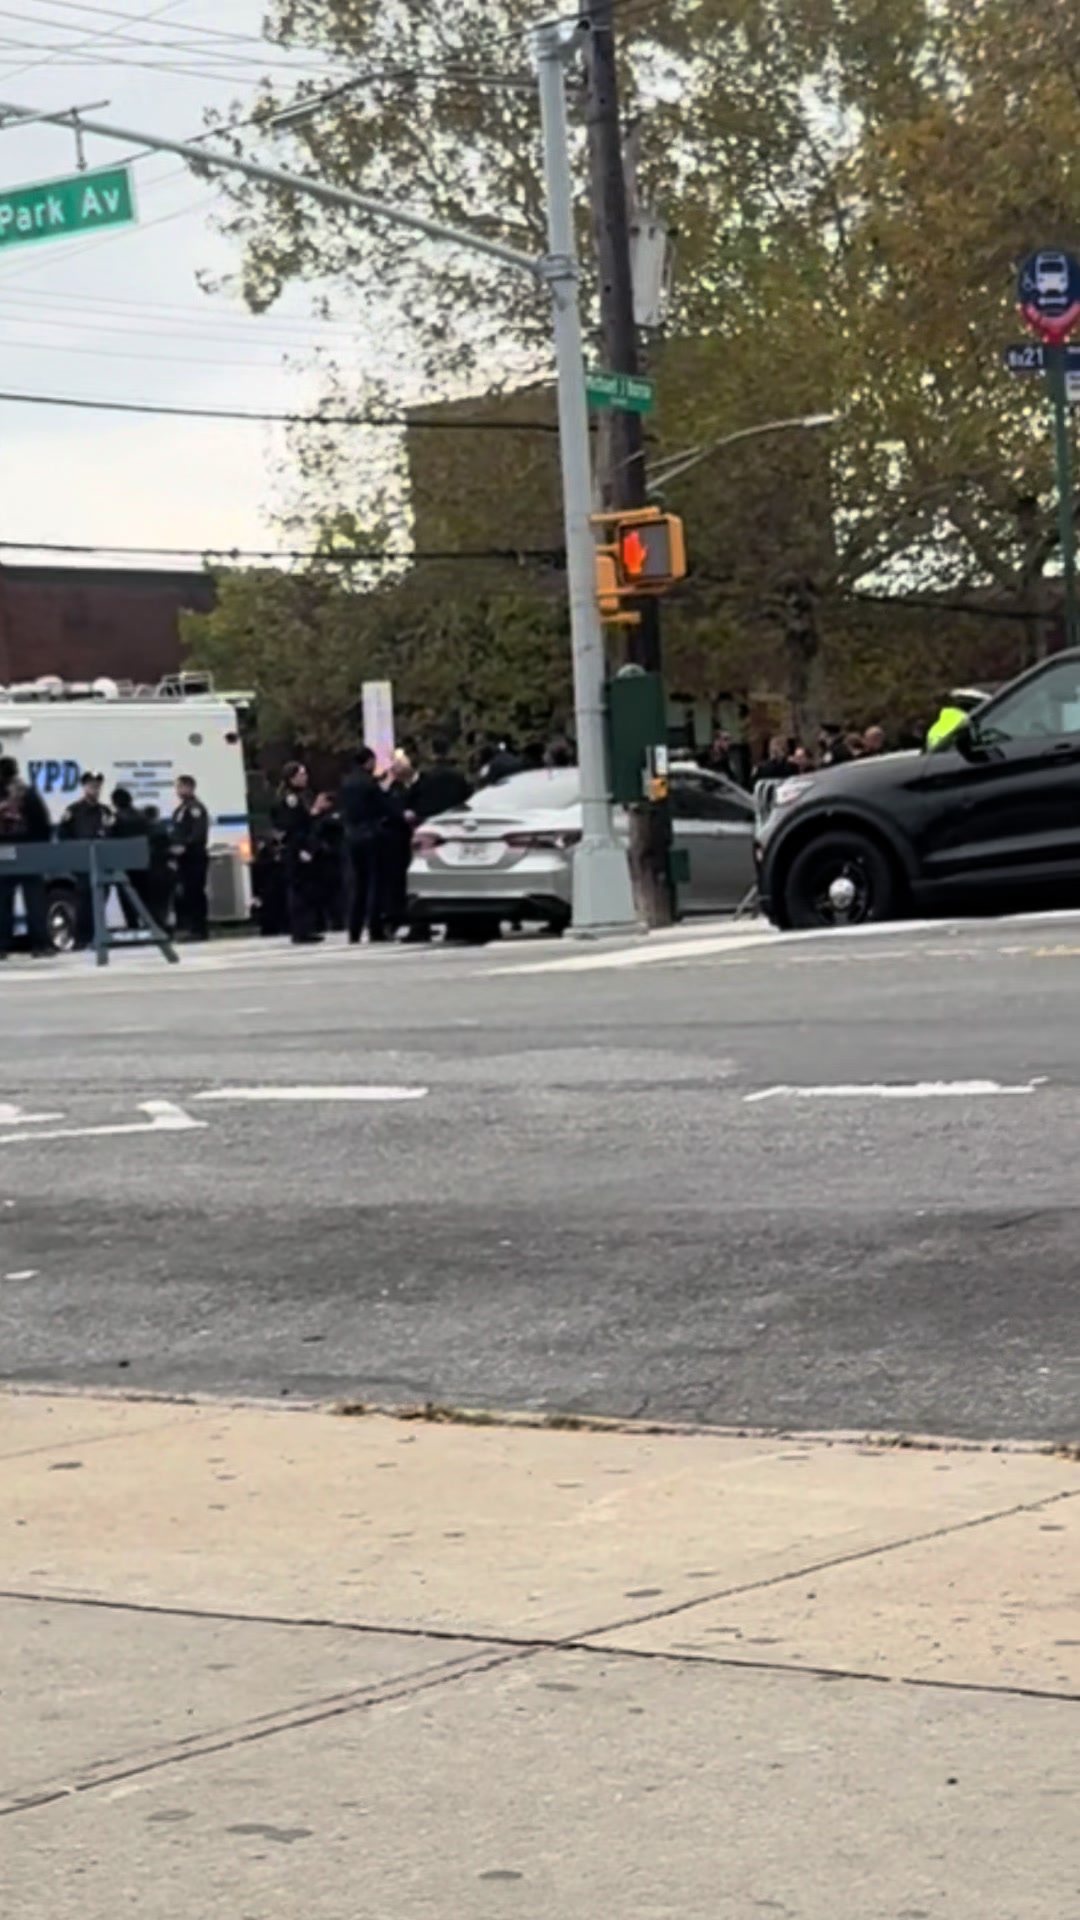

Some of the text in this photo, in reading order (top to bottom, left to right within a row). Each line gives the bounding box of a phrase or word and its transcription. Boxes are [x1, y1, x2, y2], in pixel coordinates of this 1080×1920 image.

[0, 185, 119, 235] Park Av
[27, 759, 81, 793] YPD
